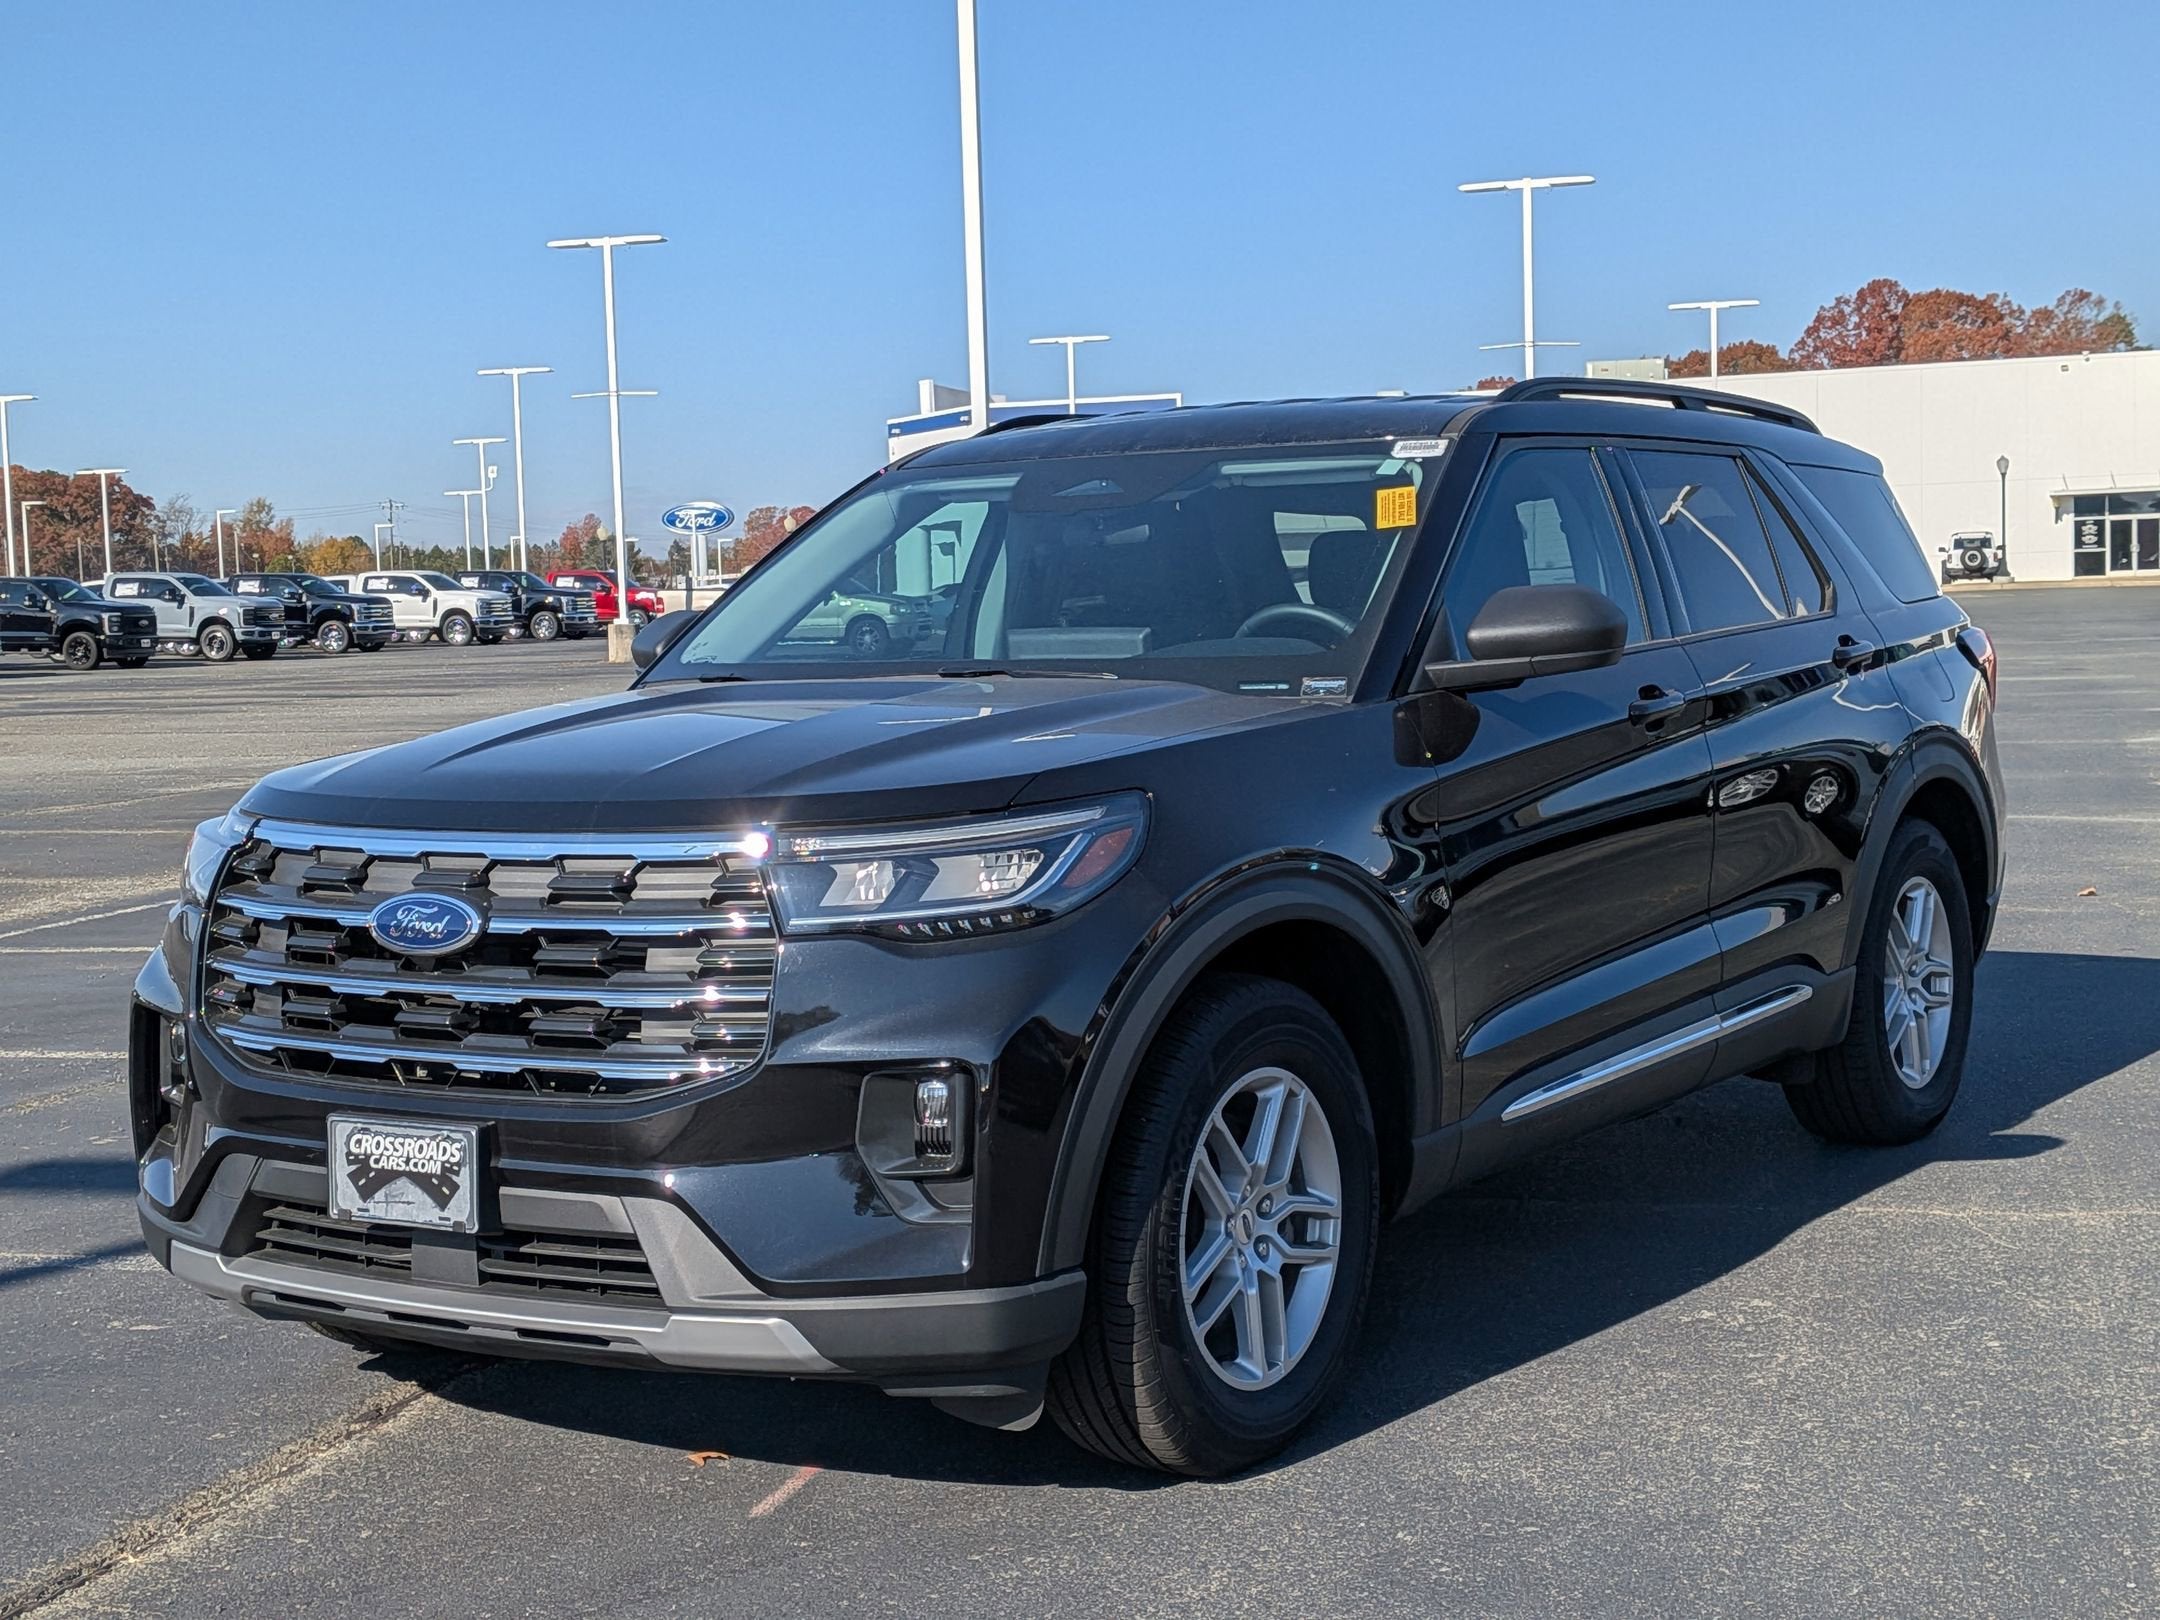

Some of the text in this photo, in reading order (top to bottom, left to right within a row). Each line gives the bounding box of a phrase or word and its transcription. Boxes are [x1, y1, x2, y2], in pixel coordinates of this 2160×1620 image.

[674, 509, 717, 527] Ford
[389, 904, 451, 939] Ford
[349, 1133, 462, 1163] CROSSROADS
[369, 1155, 442, 1175] CARS.COM
